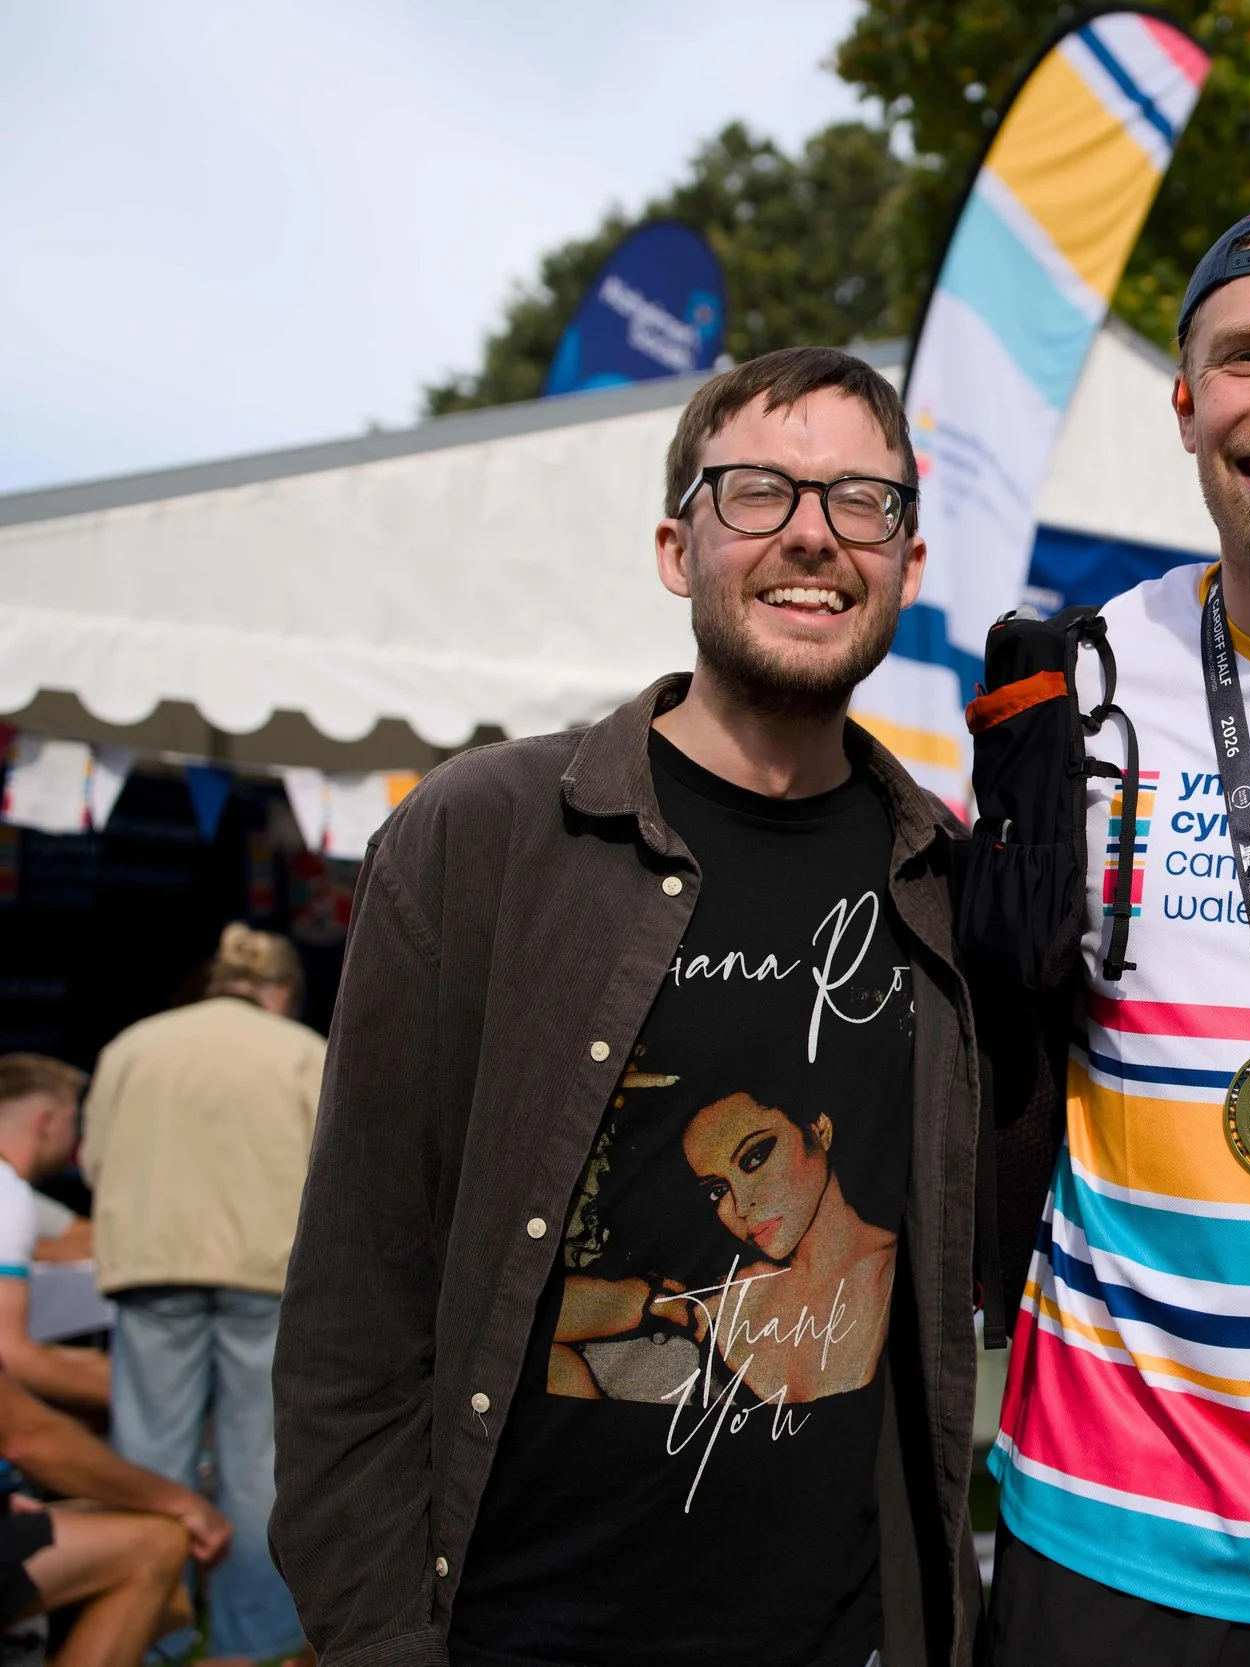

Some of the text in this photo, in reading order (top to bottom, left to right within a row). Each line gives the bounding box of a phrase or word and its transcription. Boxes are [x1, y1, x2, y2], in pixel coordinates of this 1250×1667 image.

[1212, 598, 1232, 687] CARDIFF HALF
[1220, 716, 1240, 758] 2026
[1164, 891, 1250, 924] wale
[667, 944, 801, 987] iana
[655, 1254, 857, 1408] Thank
[661, 1353, 811, 1513] You
